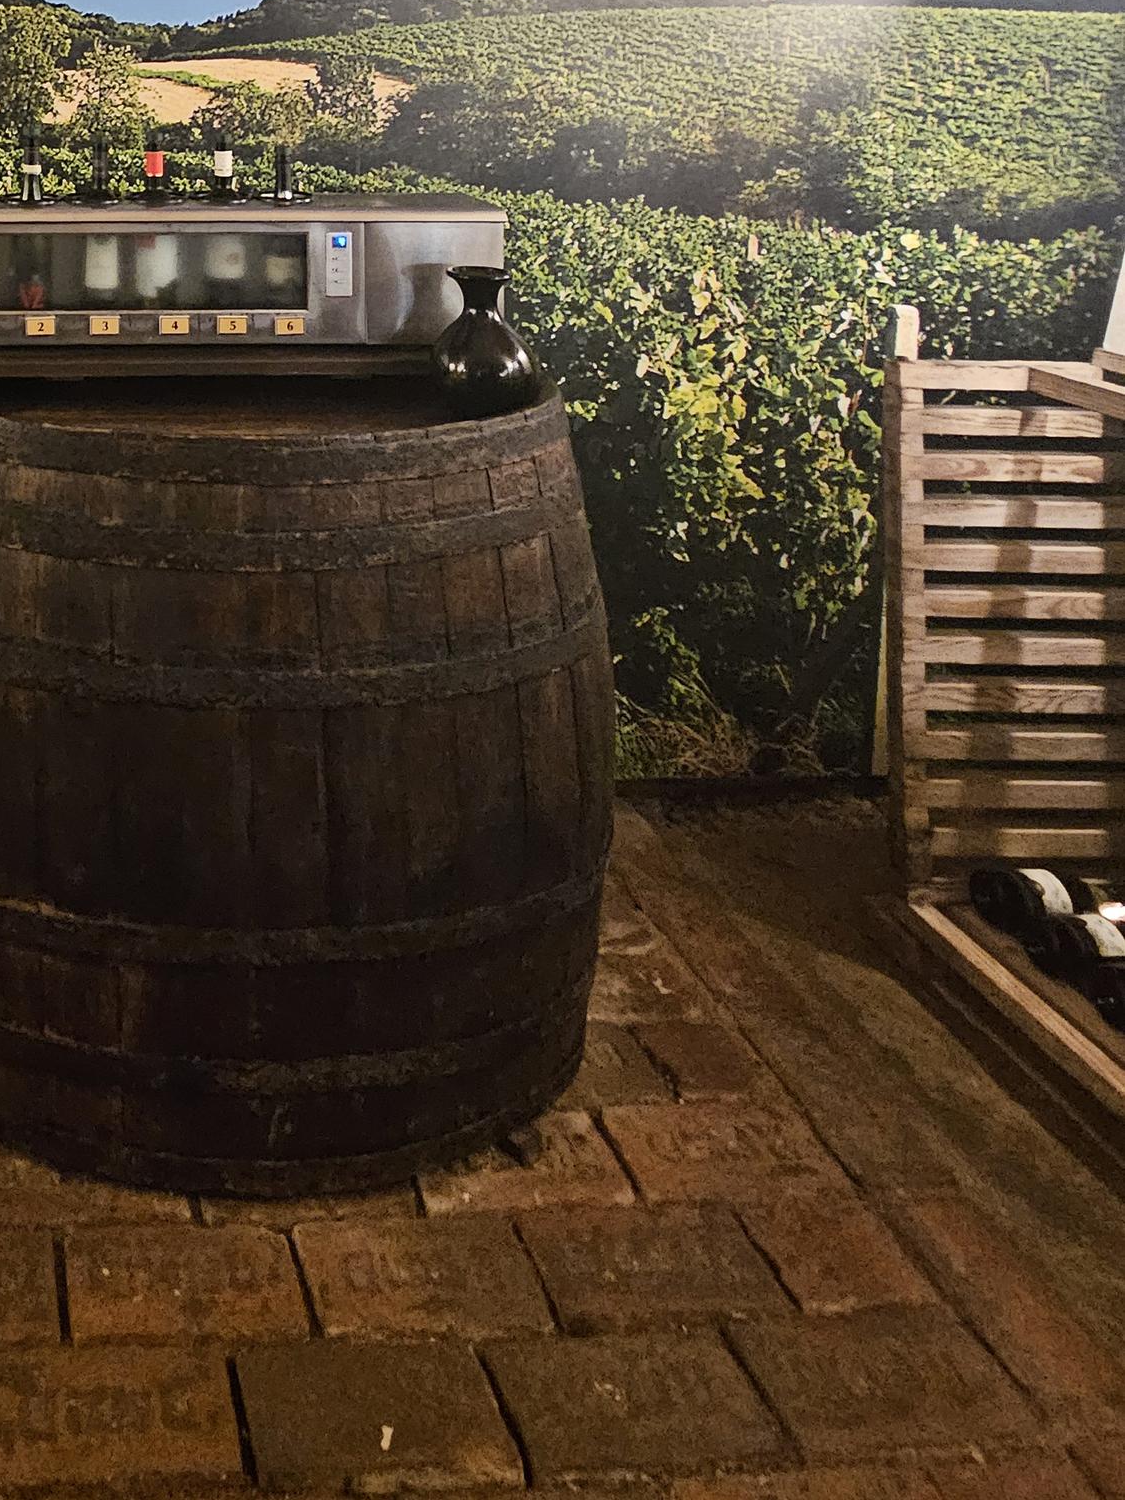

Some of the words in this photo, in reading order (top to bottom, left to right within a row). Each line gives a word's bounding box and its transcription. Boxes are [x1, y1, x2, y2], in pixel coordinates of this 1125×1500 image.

[37, 322, 44, 332] 2
[101, 321, 109, 332] 3
[171, 321, 179, 331] 4
[229, 321, 237, 331] 5
[286, 322, 294, 332] 6
